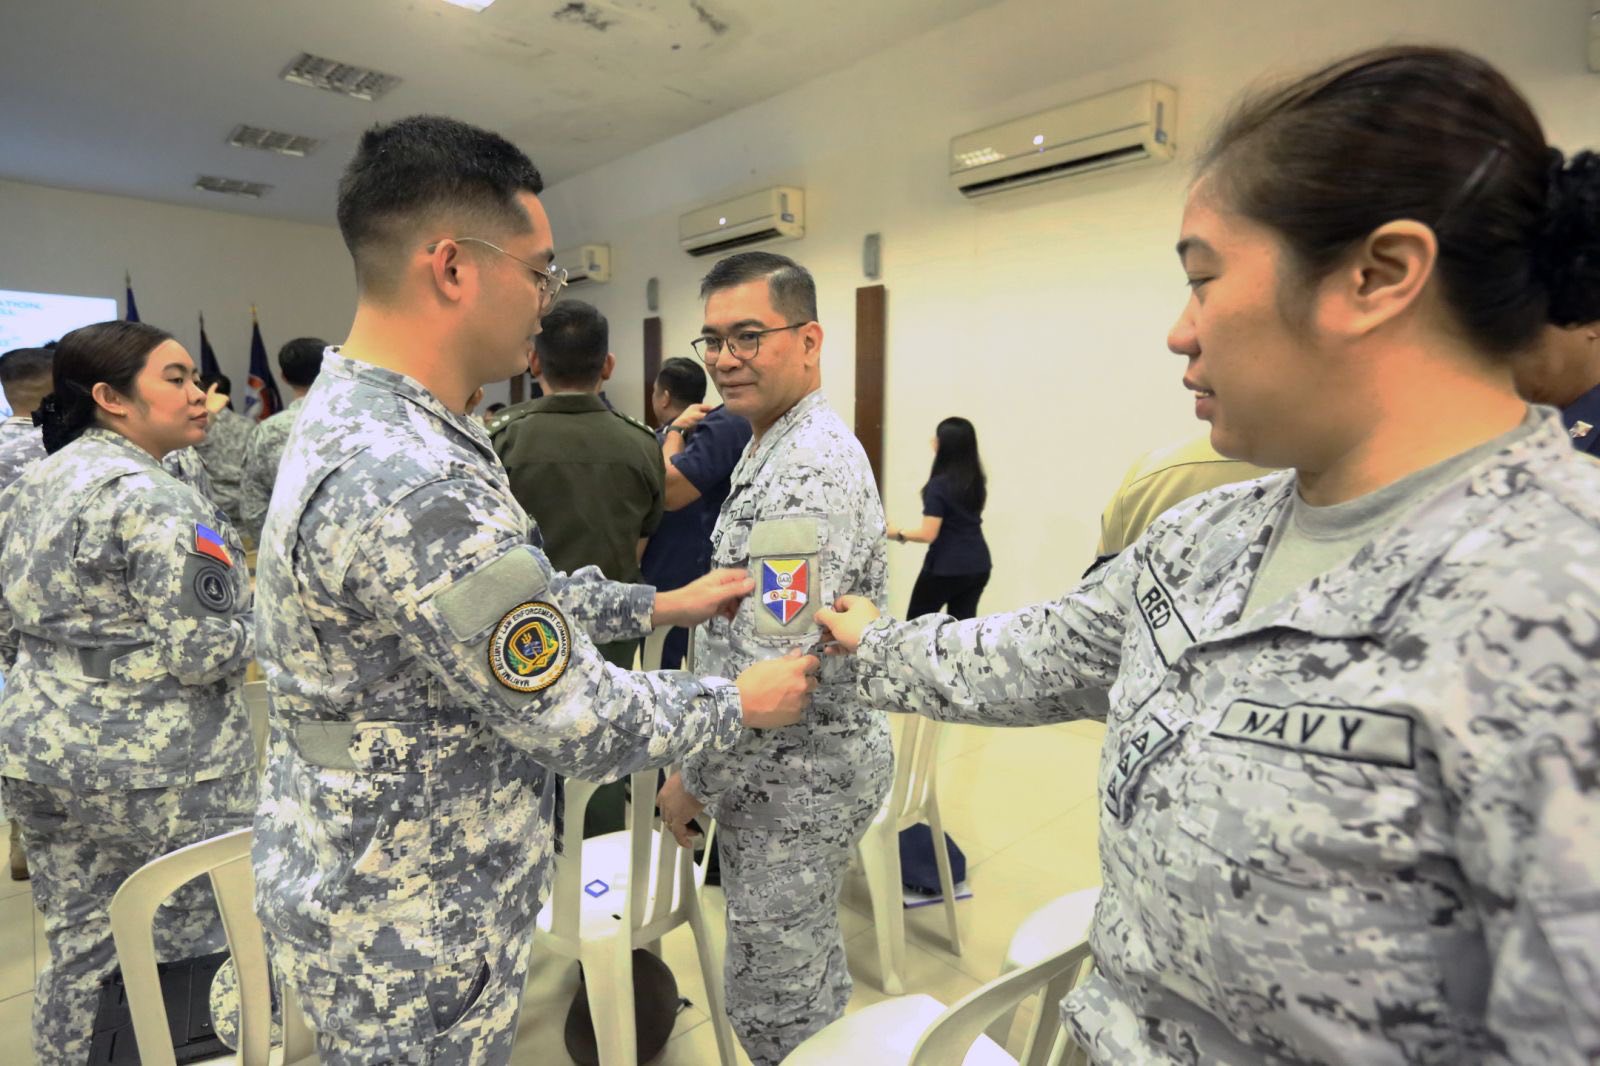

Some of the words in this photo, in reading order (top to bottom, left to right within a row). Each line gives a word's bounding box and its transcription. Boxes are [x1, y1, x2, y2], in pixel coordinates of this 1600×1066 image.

[1141, 586, 1171, 630] RED
[512, 608, 556, 623] ENFORCEMENT
[556, 622, 567, 657] COMMAND
[1239, 711, 1364, 751] NAVY
